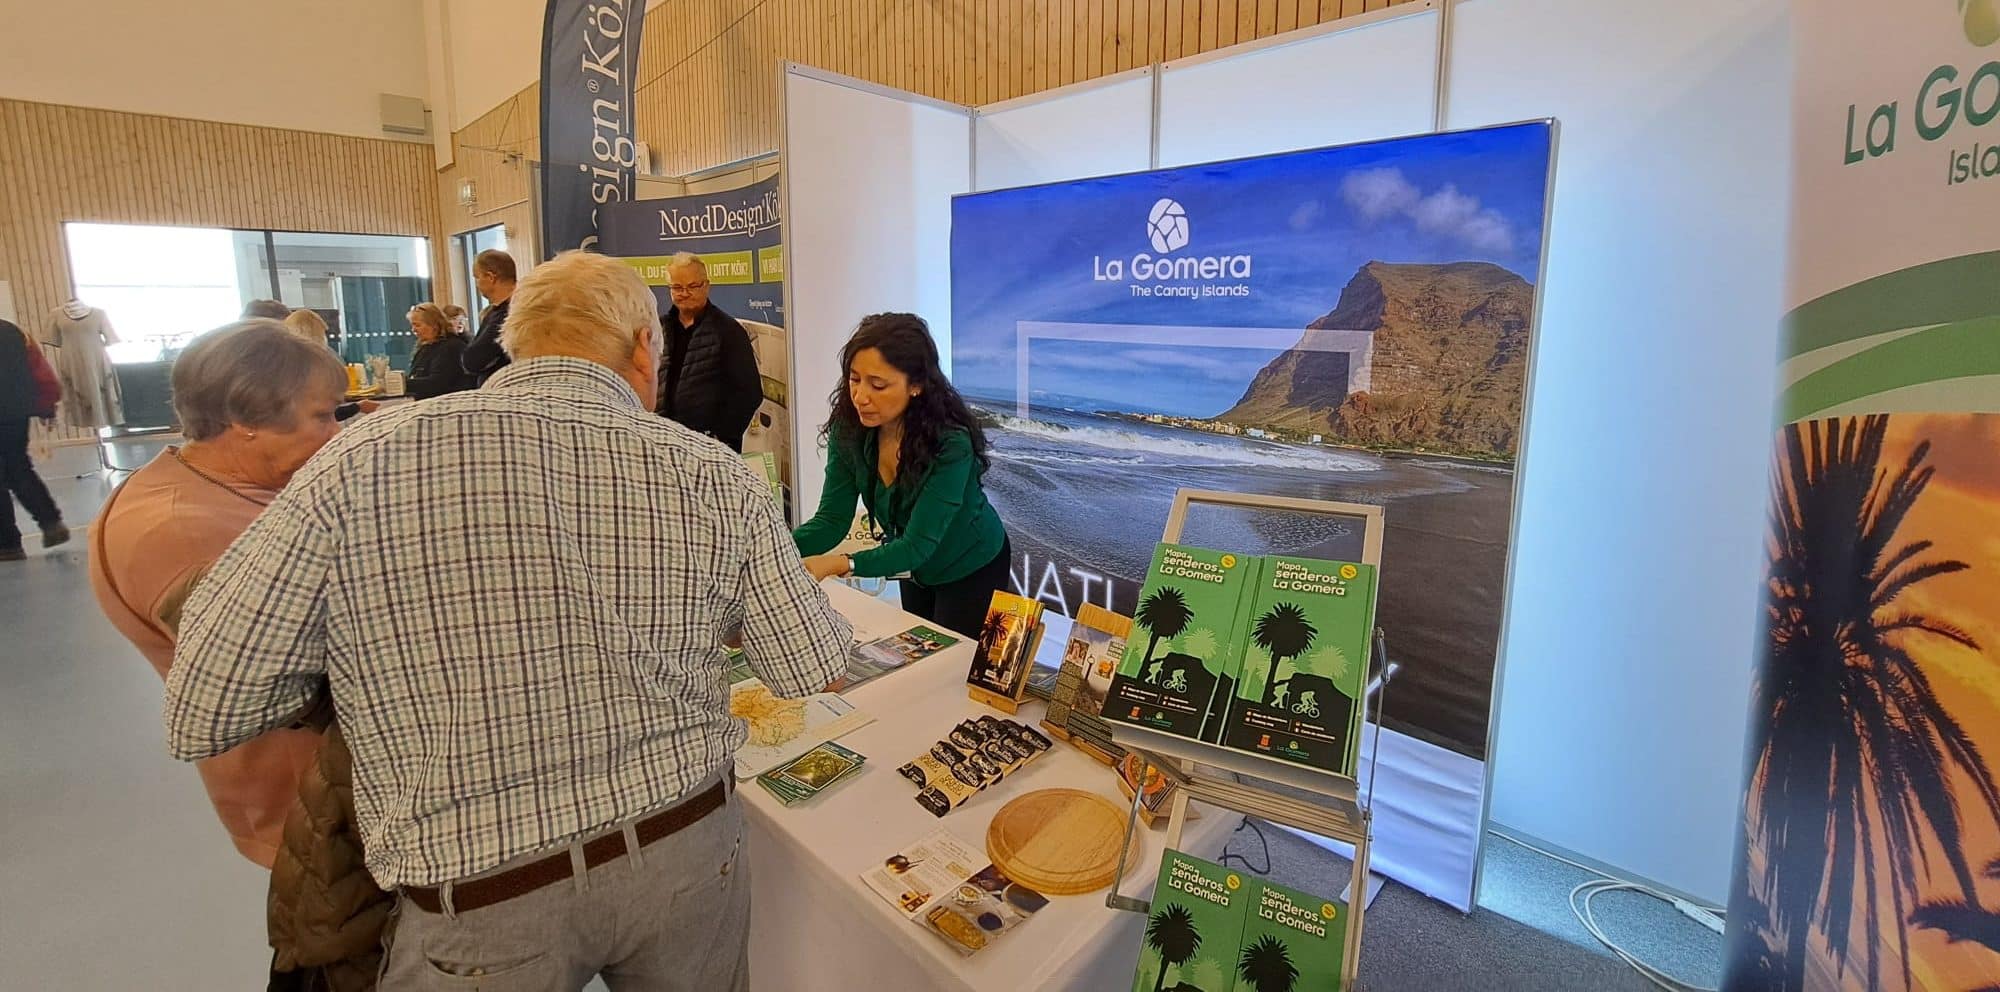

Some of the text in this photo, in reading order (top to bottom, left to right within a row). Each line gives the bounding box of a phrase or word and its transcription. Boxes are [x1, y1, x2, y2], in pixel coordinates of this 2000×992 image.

[582, 0, 623, 86] Kö
[1844, 101, 1898, 165] La
[647, 265, 659, 279] DU
[1094, 253, 1251, 281] La Gomera
[1130, 283, 1250, 300] The Canary Islands
[1165, 548, 1187, 558] Mapa
[1163, 556, 1218, 572] senderos
[1276, 561, 1301, 571] Mapa
[1160, 564, 1224, 583] La Gomera
[1275, 569, 1338, 584] senderos
[1273, 578, 1345, 596] La Gomera
[1173, 857, 1194, 872] Mapa
[1171, 867, 1224, 892] senderos
[1168, 876, 1182, 889] La
[1184, 882, 1229, 906] Gomera
[1262, 886, 1286, 901] Mapa
[1261, 896, 1319, 922] senderos
[1259, 905, 1273, 919] La
[1276, 911, 1326, 937] Gomera
